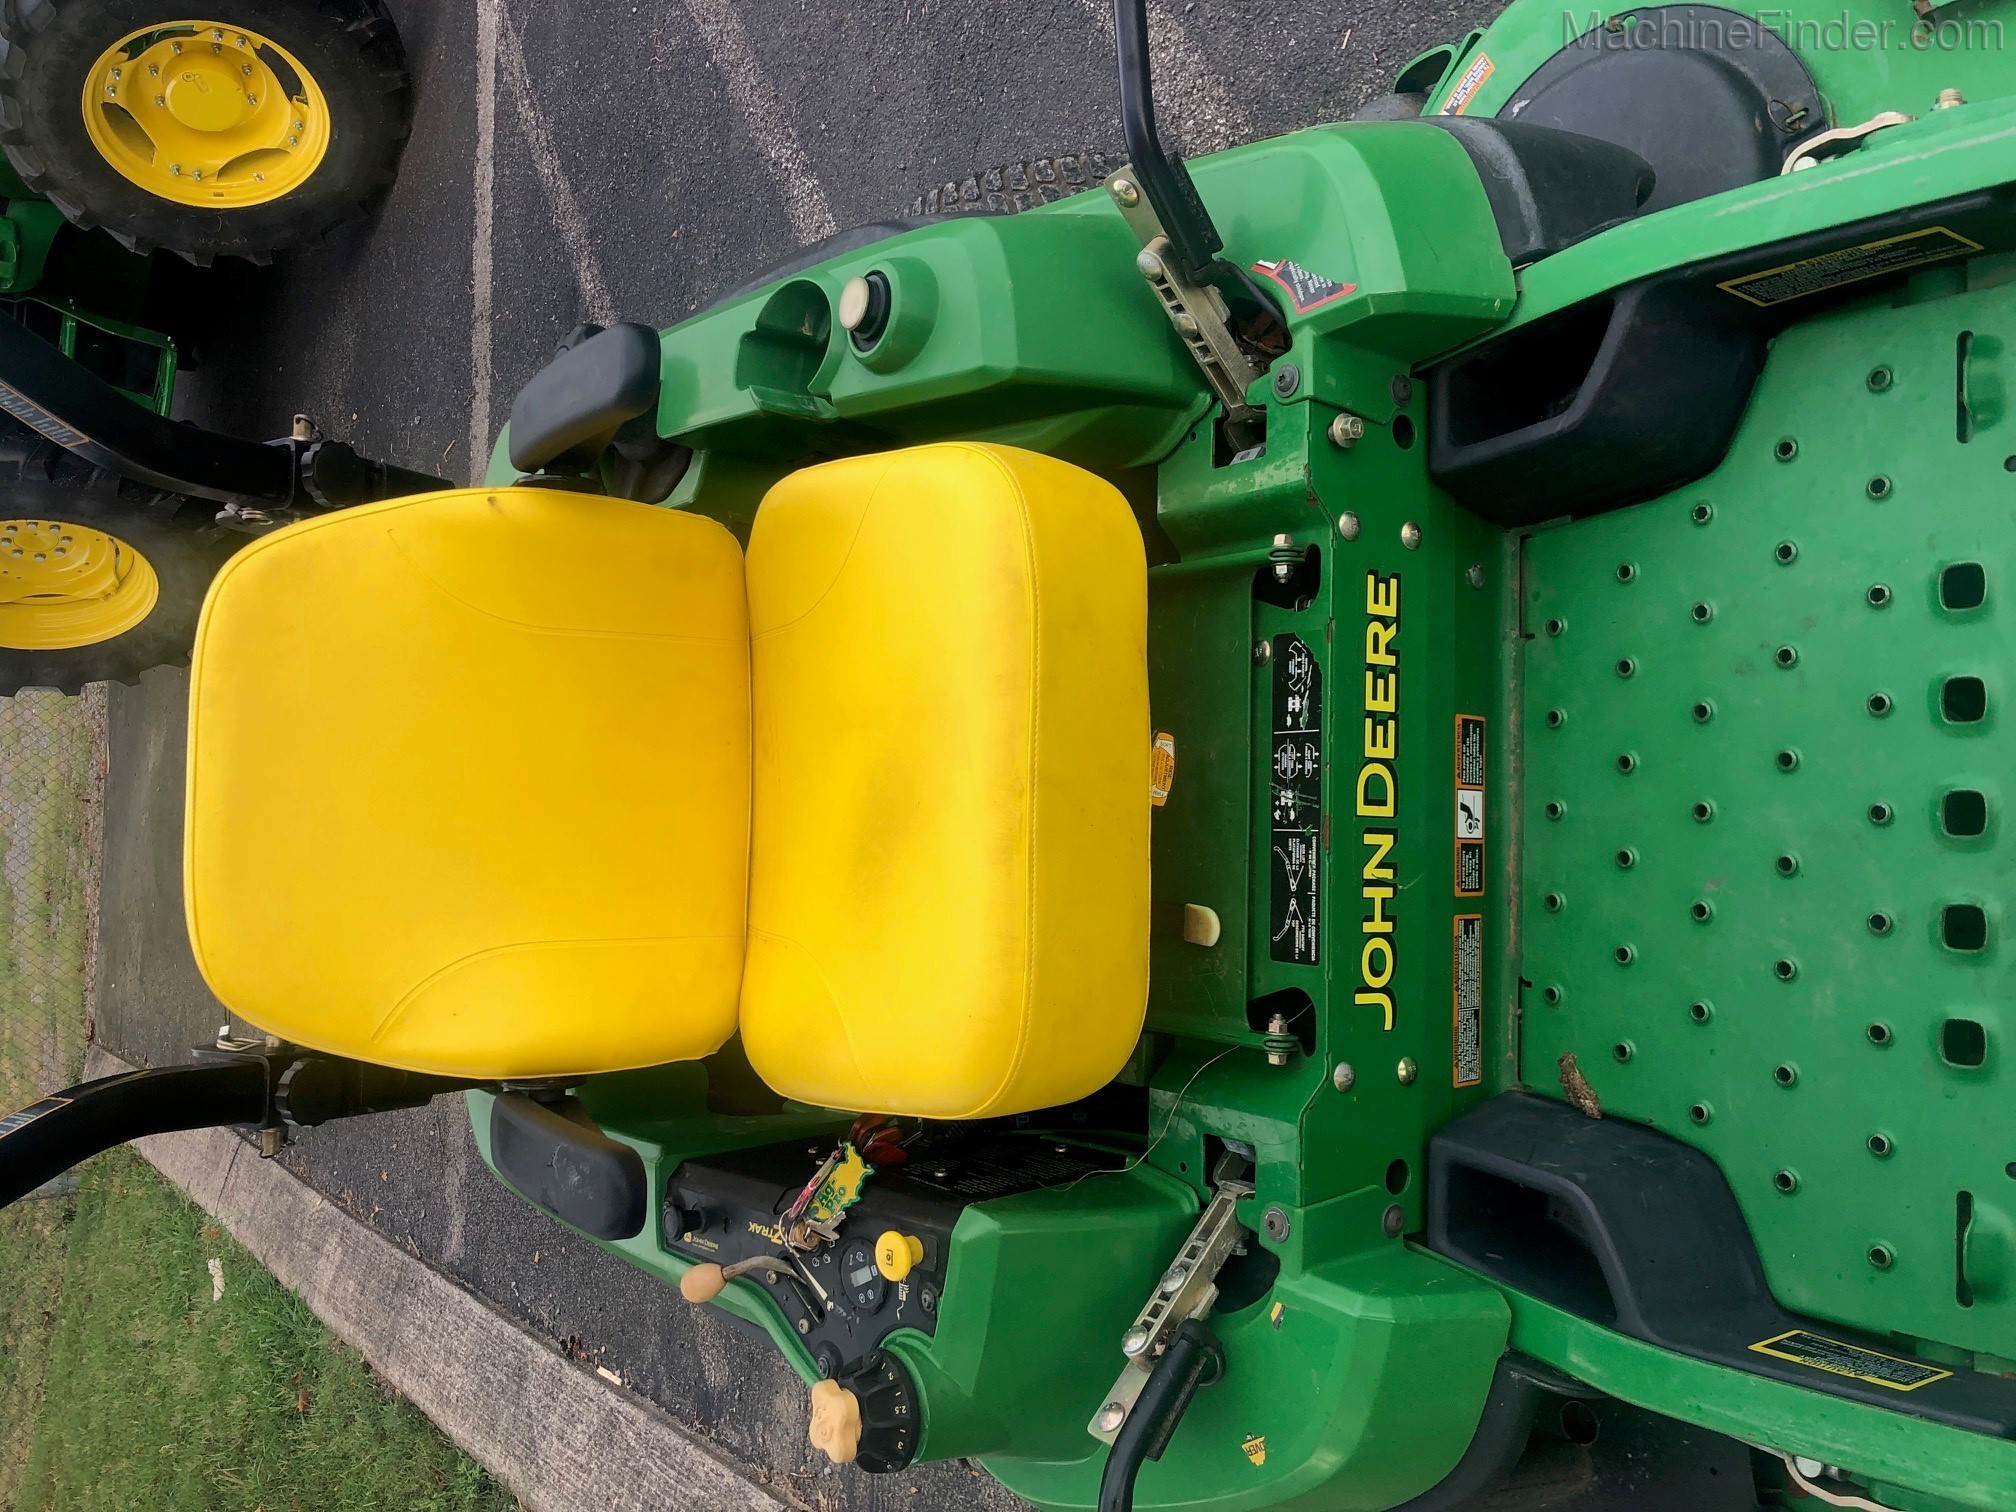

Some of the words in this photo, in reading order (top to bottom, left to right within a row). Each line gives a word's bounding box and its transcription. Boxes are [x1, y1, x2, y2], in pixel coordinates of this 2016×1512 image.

[1356, 574, 1397, 817] DEERE
[1355, 833, 1394, 1031] JOHN
[894, 1405, 906, 1415] 2.5
[897, 1441, 904, 1449] 3
